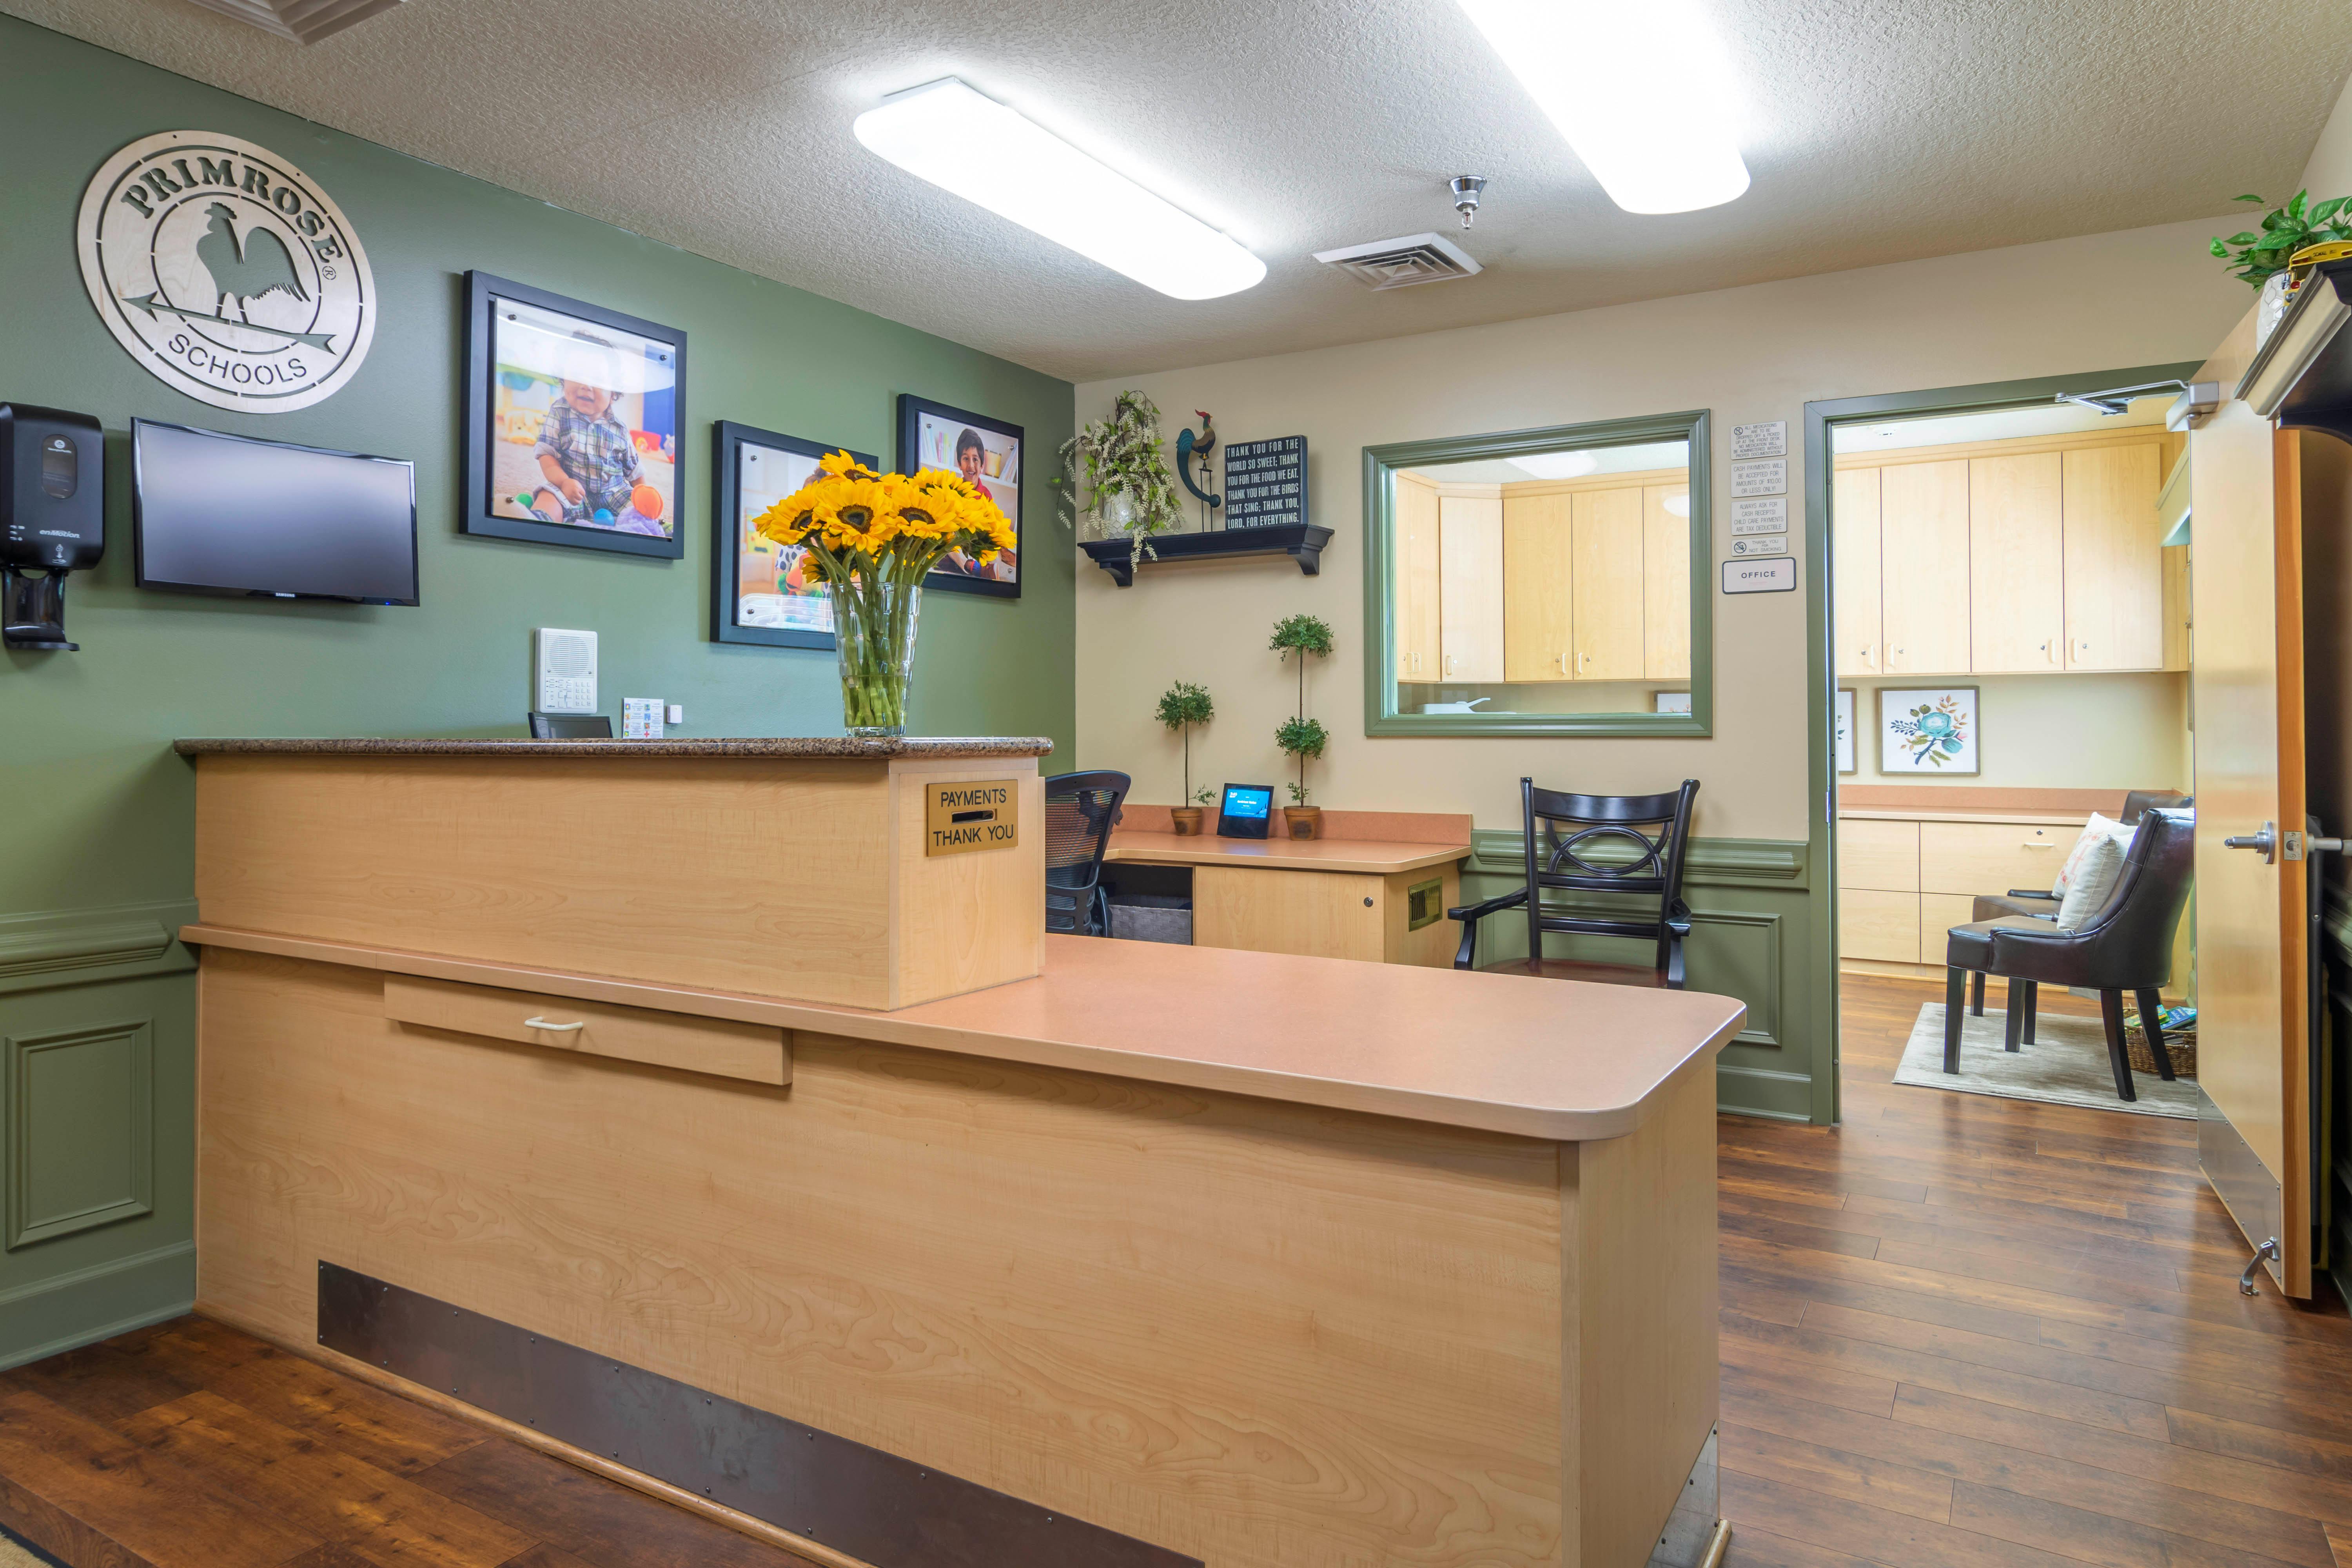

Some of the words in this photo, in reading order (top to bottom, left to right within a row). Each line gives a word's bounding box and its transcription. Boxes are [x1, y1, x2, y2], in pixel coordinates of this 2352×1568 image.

[121, 157, 343, 263] PRIMROSE
[169, 334, 307, 385] SCHOOLS
[1227, 445, 1249, 458] THANK
[1253, 443, 1265, 454] YOU
[1269, 441, 1282, 452] FOR
[1286, 439, 1298, 450] THE
[1227, 460, 1246, 472] WORLD
[1248, 459, 1256, 469] SO
[1258, 456, 1277, 468] SWEET;
[1279, 453, 1298, 465] THANK
[1227, 475, 1238, 486] YOU
[1239, 474, 1249, 485] FOR
[1251, 473, 1261, 483] THE
[1262, 471, 1276, 482] FOOD
[1278, 470, 1286, 480] WE
[1287, 468, 1299, 479] EAT.
[1227, 489, 1245, 501] THANK
[1247, 488, 1257, 498] YOU
[1258, 486, 1269, 497] FOR
[1270, 485, 1280, 495] THE
[1282, 483, 1298, 494] BIRDS
[1228, 504, 1242, 515] THAT
[1244, 502, 1261, 513] SING;
[1263, 499, 1283, 511] THANK
[1285, 497, 1299, 509] YOU,
[1228, 518, 1245, 529] LORD,
[1247, 516, 1258, 527] FOR
[1260, 512, 1299, 526] EVERYTHING.
[40, 530, 80, 538] enMotion
[941, 788, 1006, 807] PAYMENTS
[933, 827, 982, 846] THANK
[987, 824, 1013, 841] YOU
